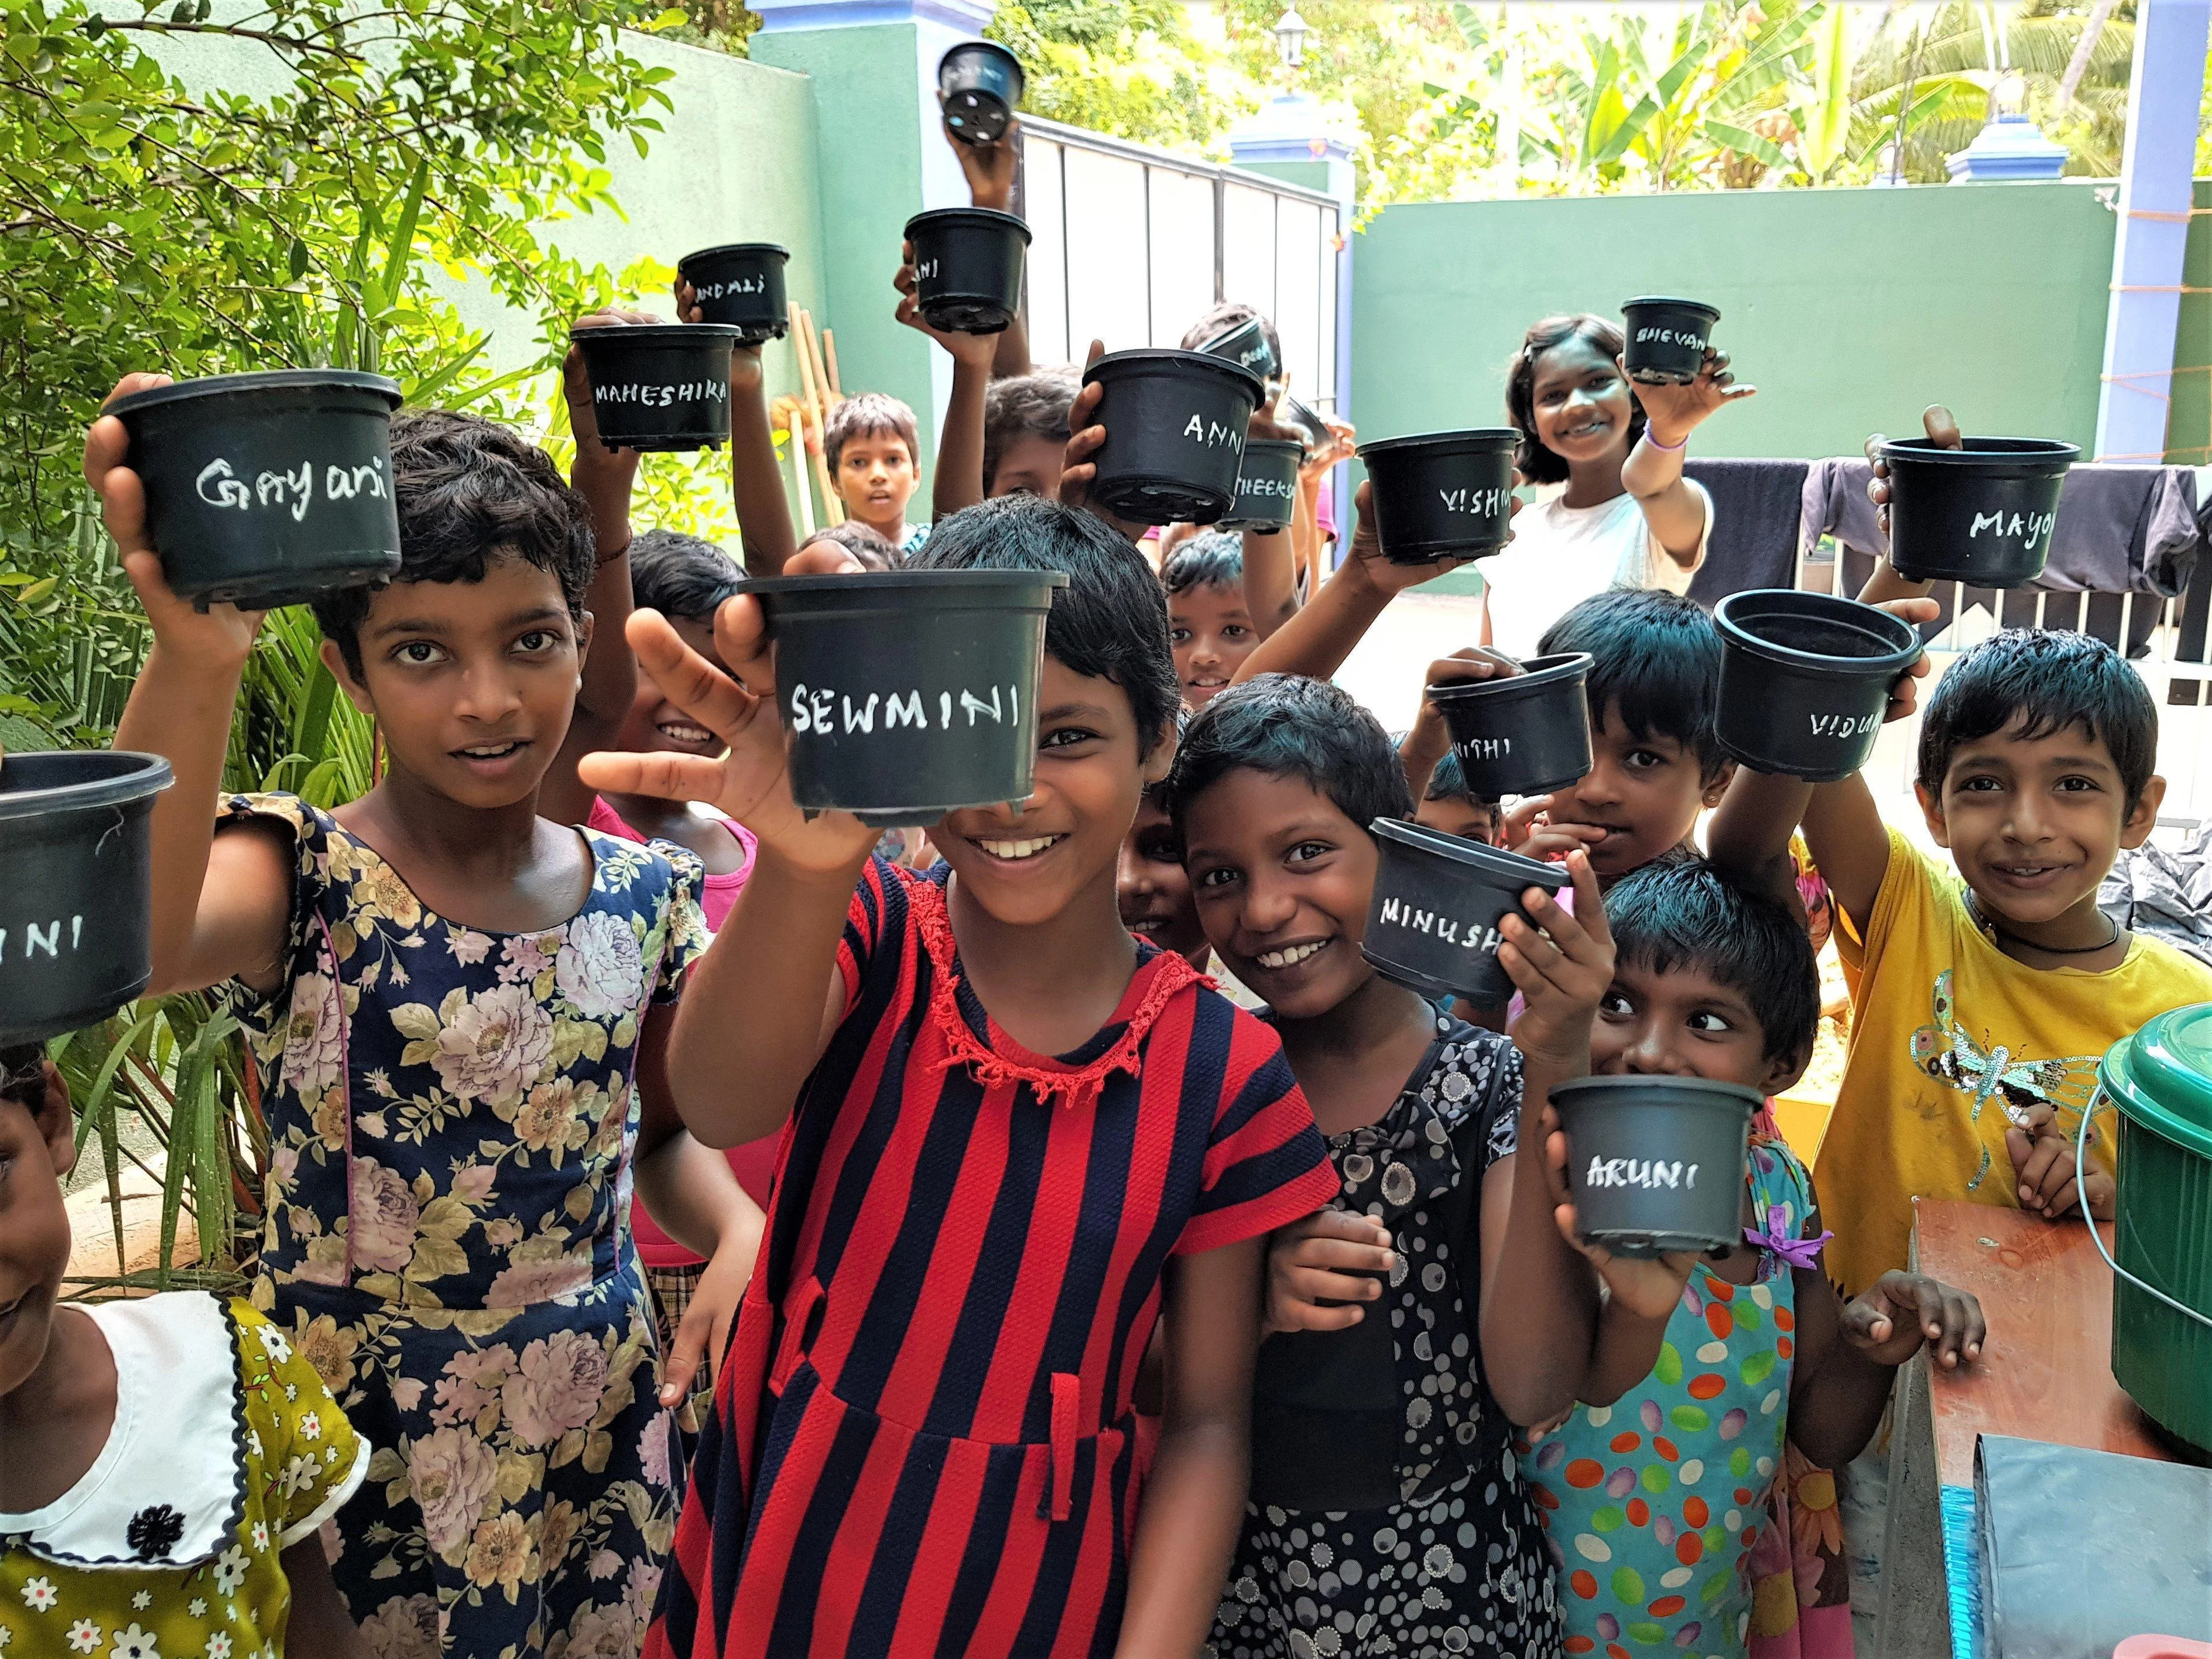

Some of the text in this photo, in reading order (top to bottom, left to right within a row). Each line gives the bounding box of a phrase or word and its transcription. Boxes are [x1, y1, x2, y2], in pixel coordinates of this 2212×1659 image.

[595, 379, 726, 406] MAHESHIKA
[791, 683, 1019, 734] SEWMINI
[1379, 897, 1504, 955] MINUSH
[1586, 1154, 1699, 1190] ARUNI
